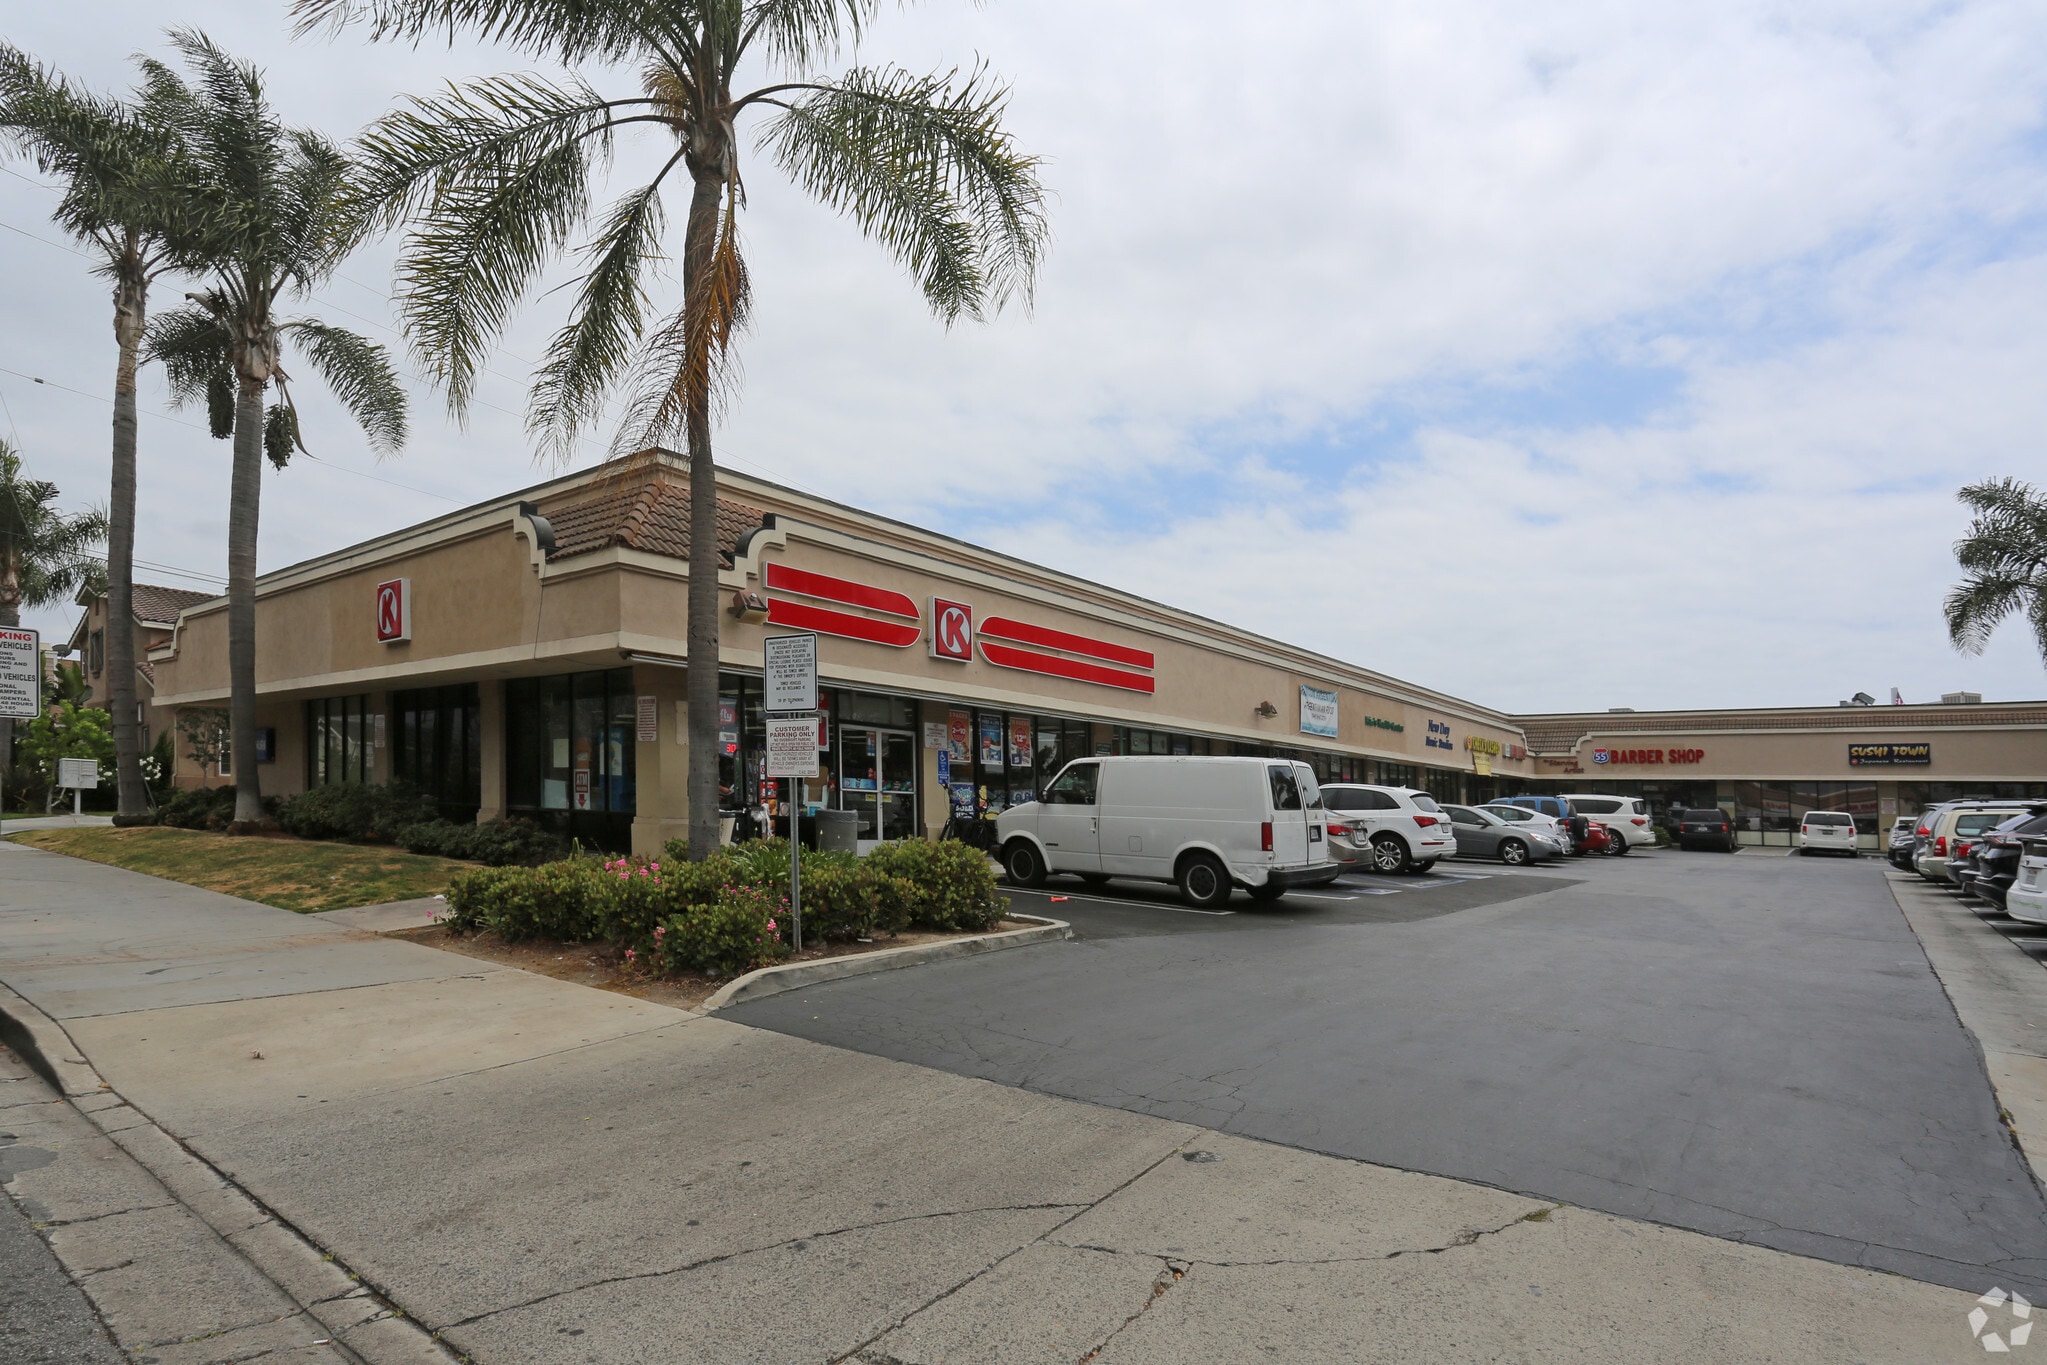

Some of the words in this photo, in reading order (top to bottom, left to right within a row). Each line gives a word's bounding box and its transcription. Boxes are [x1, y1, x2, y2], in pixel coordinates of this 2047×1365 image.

[4, 673, 35, 682] VEHICLES
[1428, 720, 1439, 733] New
[1440, 722, 1450, 738] Day
[1426, 736, 1438, 747] Music
[1439, 738, 1453, 750] Studios
[1611, 750, 1664, 764] BARBER
[1669, 748, 1704, 764] SHOP
[1851, 746, 1888, 757] SUSHI
[1892, 746, 1928, 756] TOWN
[1549, 759, 1578, 768] Starving
[576, 773, 587, 784] ATM
